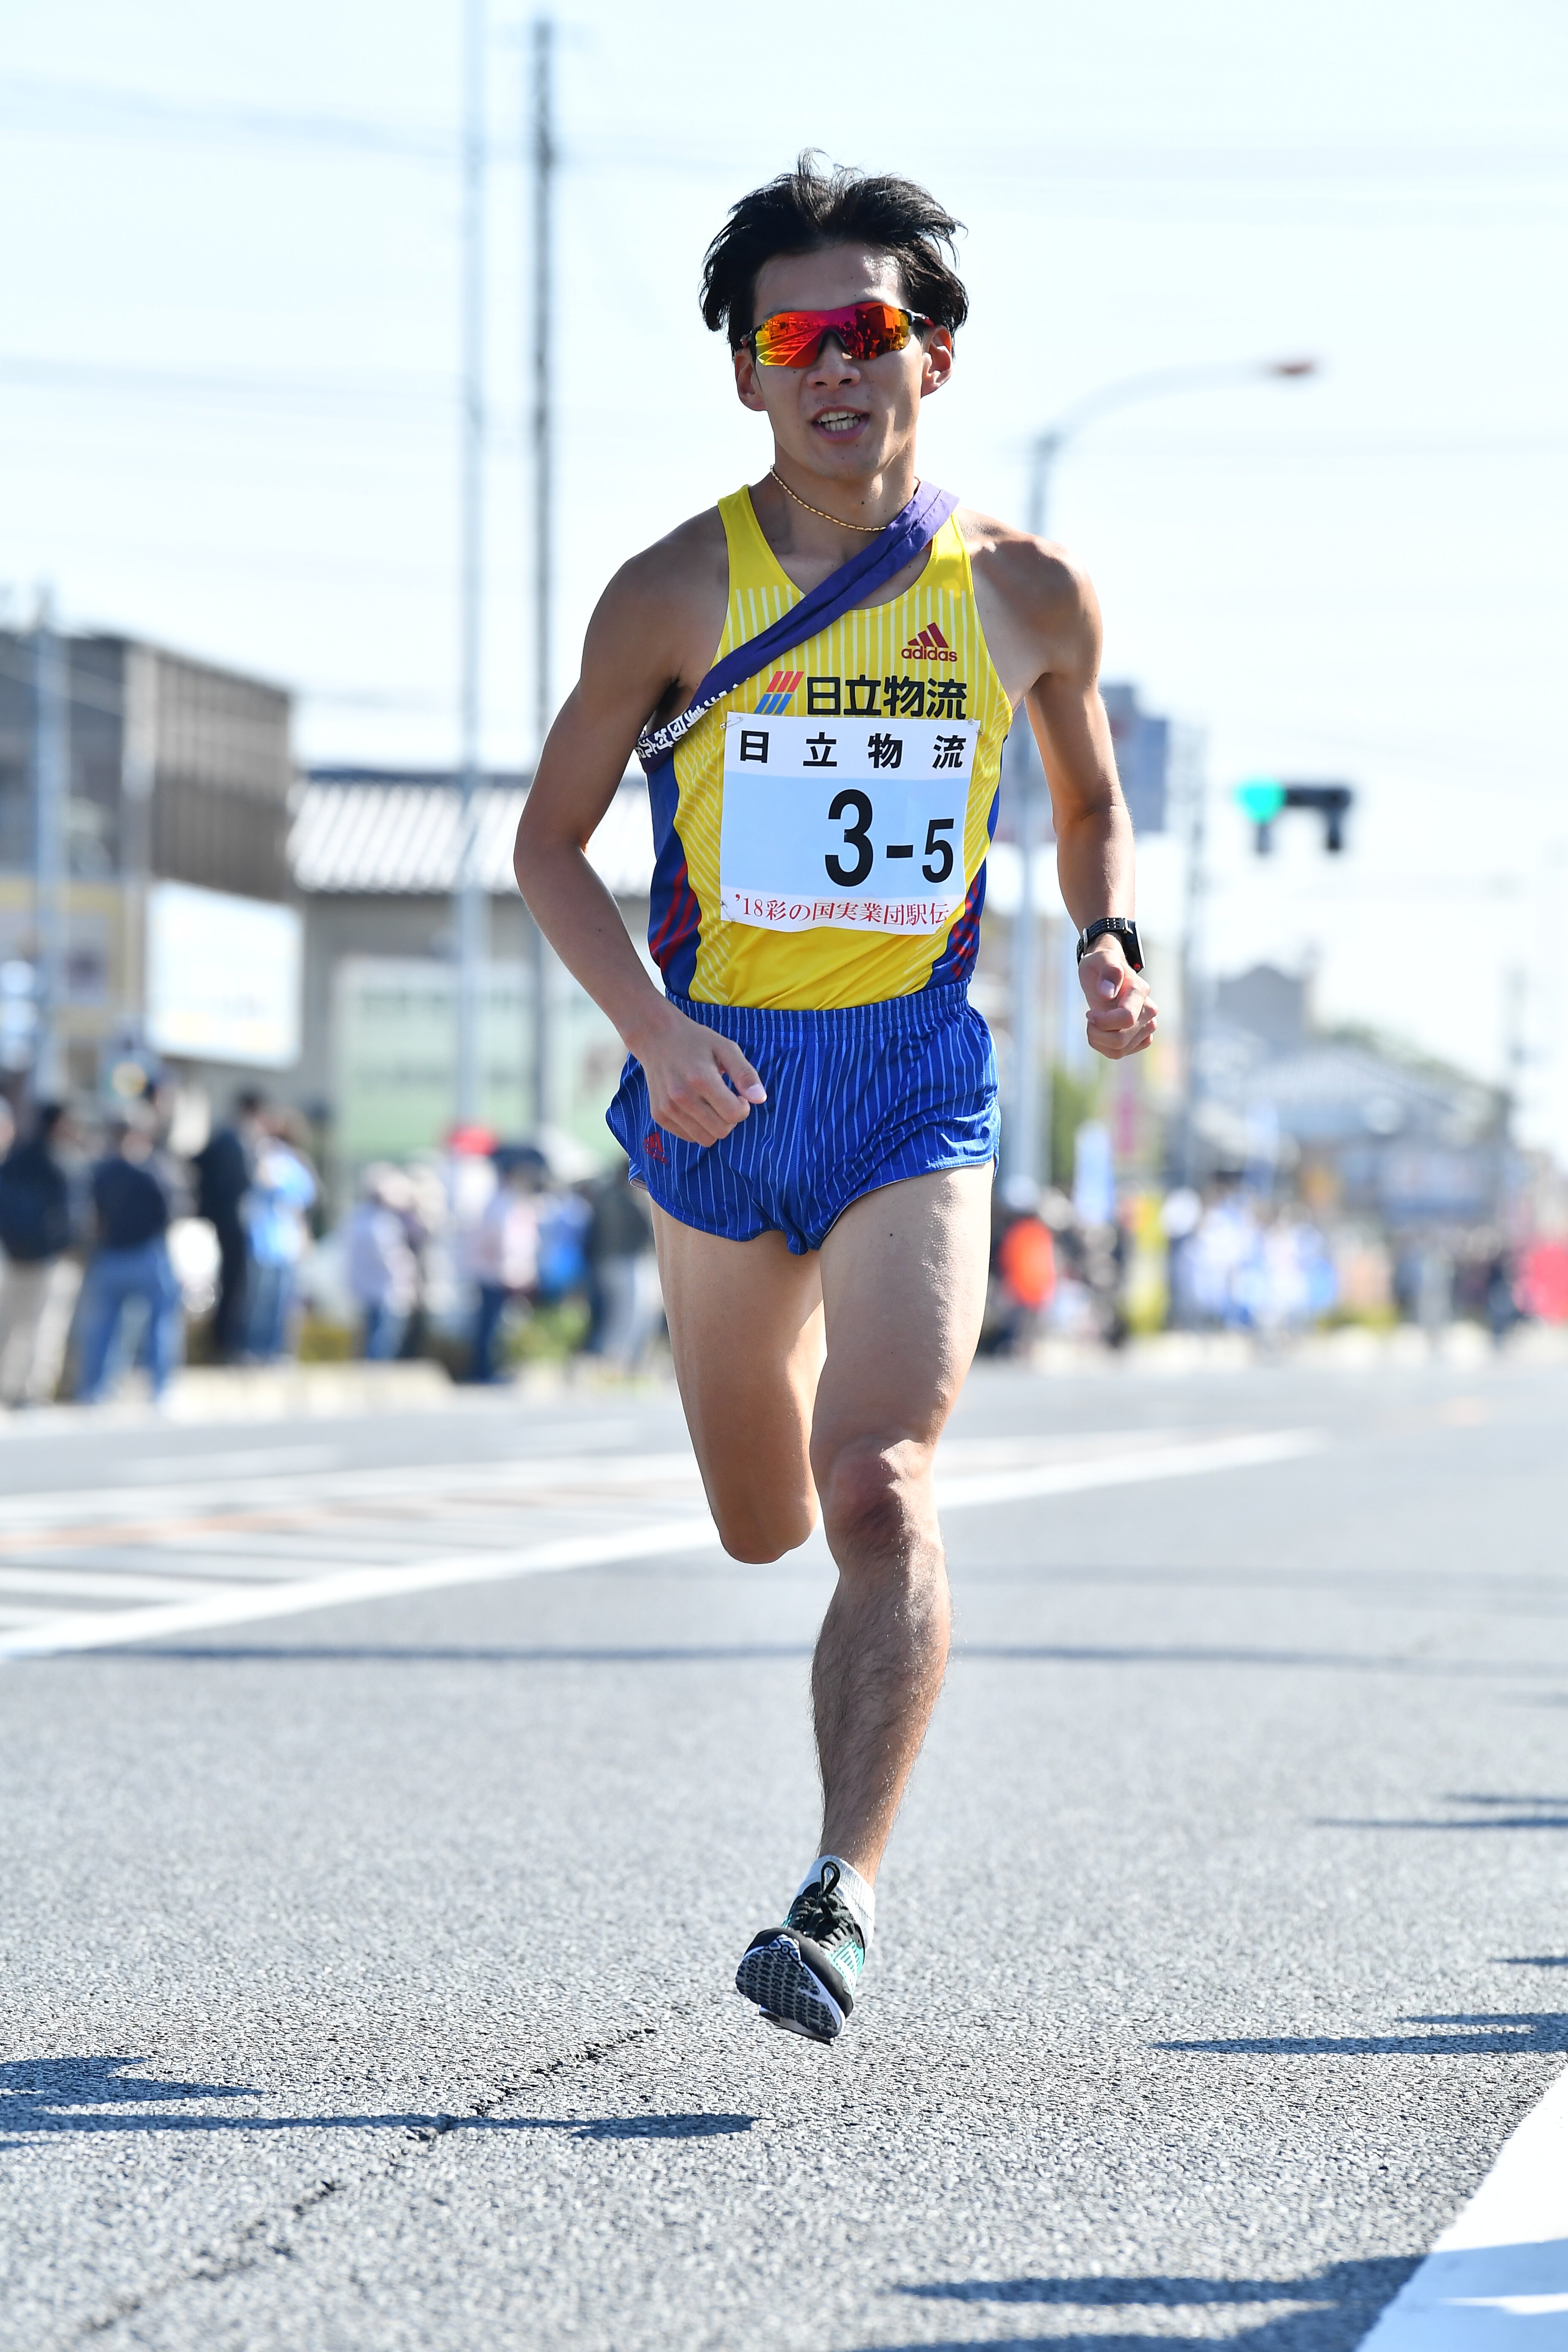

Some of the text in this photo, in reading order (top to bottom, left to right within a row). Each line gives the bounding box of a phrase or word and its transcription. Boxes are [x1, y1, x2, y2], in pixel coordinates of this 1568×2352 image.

[901, 647, 958, 662] adidas
[807, 675, 967, 720] 日立物流
[740, 730, 966, 769] 日立物流
[825, 789, 954, 887] 3-5
